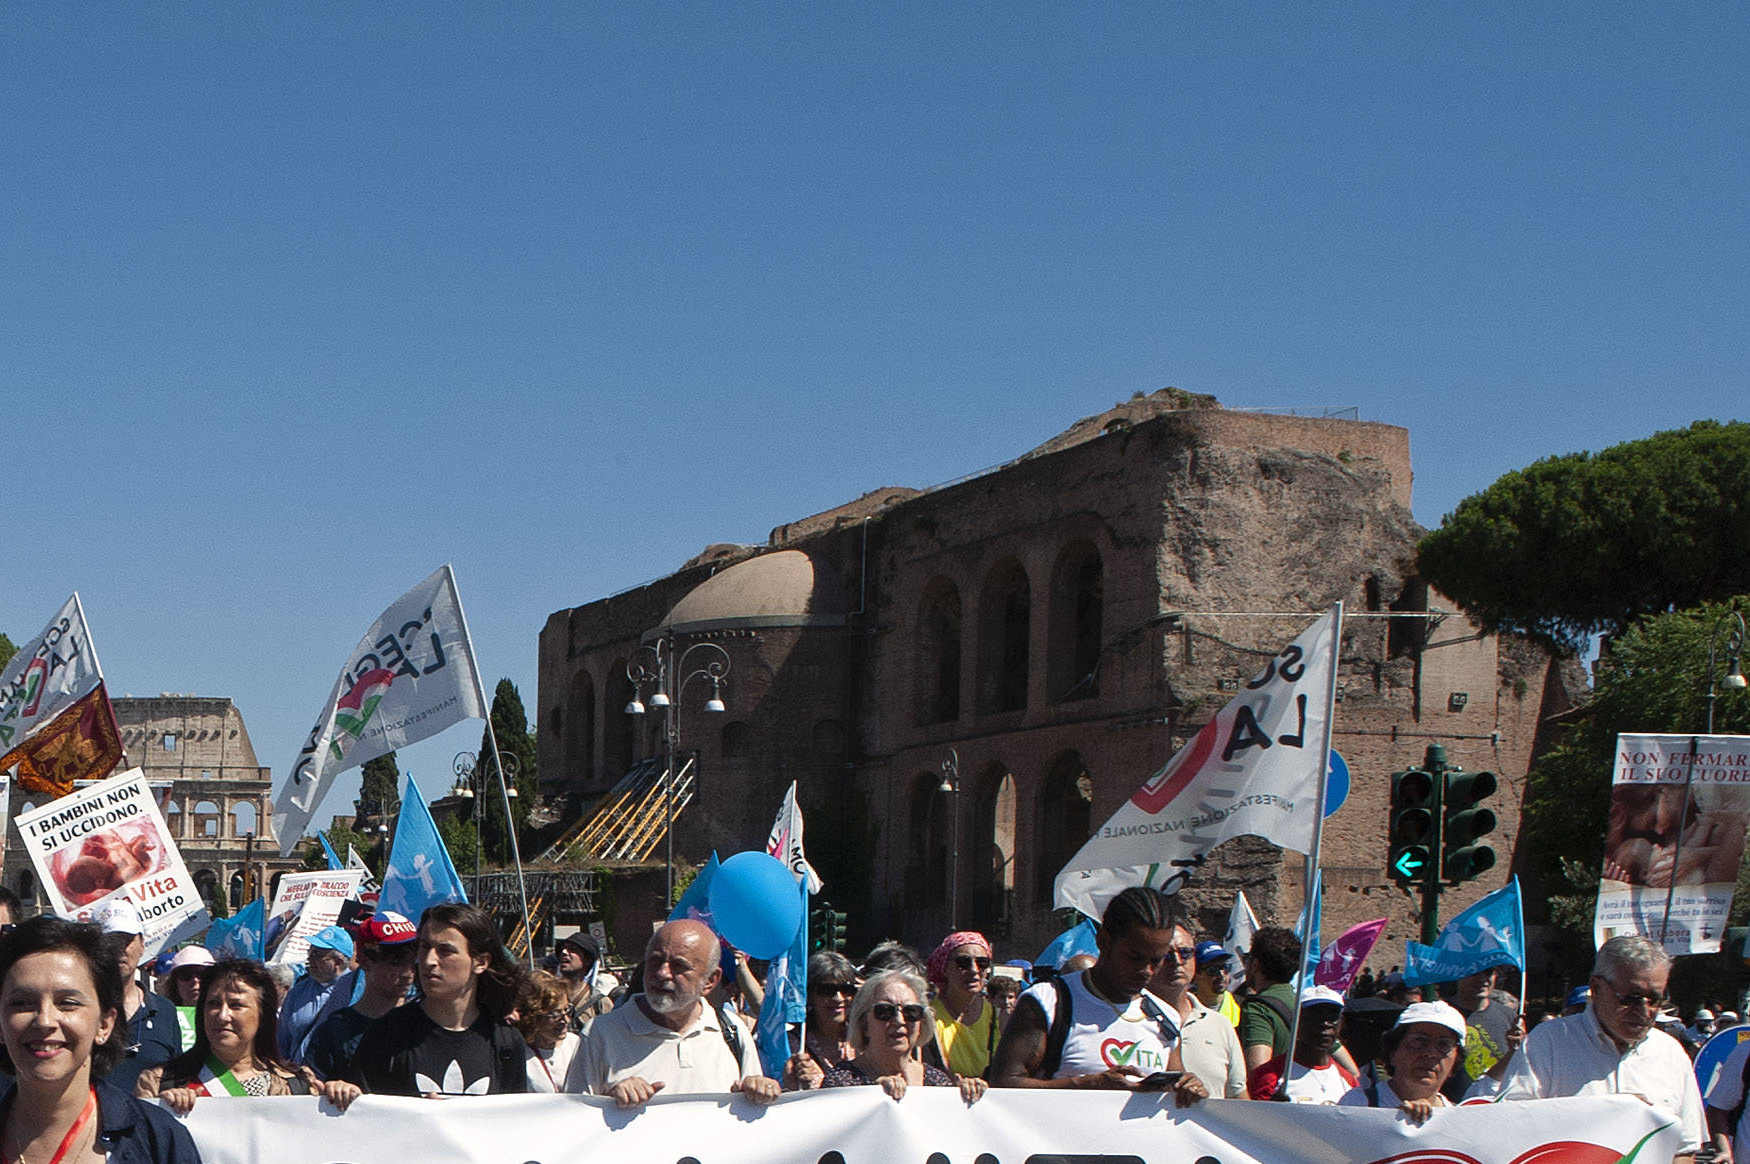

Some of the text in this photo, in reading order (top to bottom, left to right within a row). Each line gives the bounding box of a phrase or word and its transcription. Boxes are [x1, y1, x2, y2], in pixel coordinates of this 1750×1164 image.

[1618, 752, 1659, 765] NON
[1621, 767, 1639, 781] IL
[1645, 768, 1683, 781] SUO
[39, 797, 104, 833] BAMBINI
[107, 784, 141, 805] NON
[42, 803, 143, 851] SI UCCIDONO.
[131, 877, 179, 902] Vita
